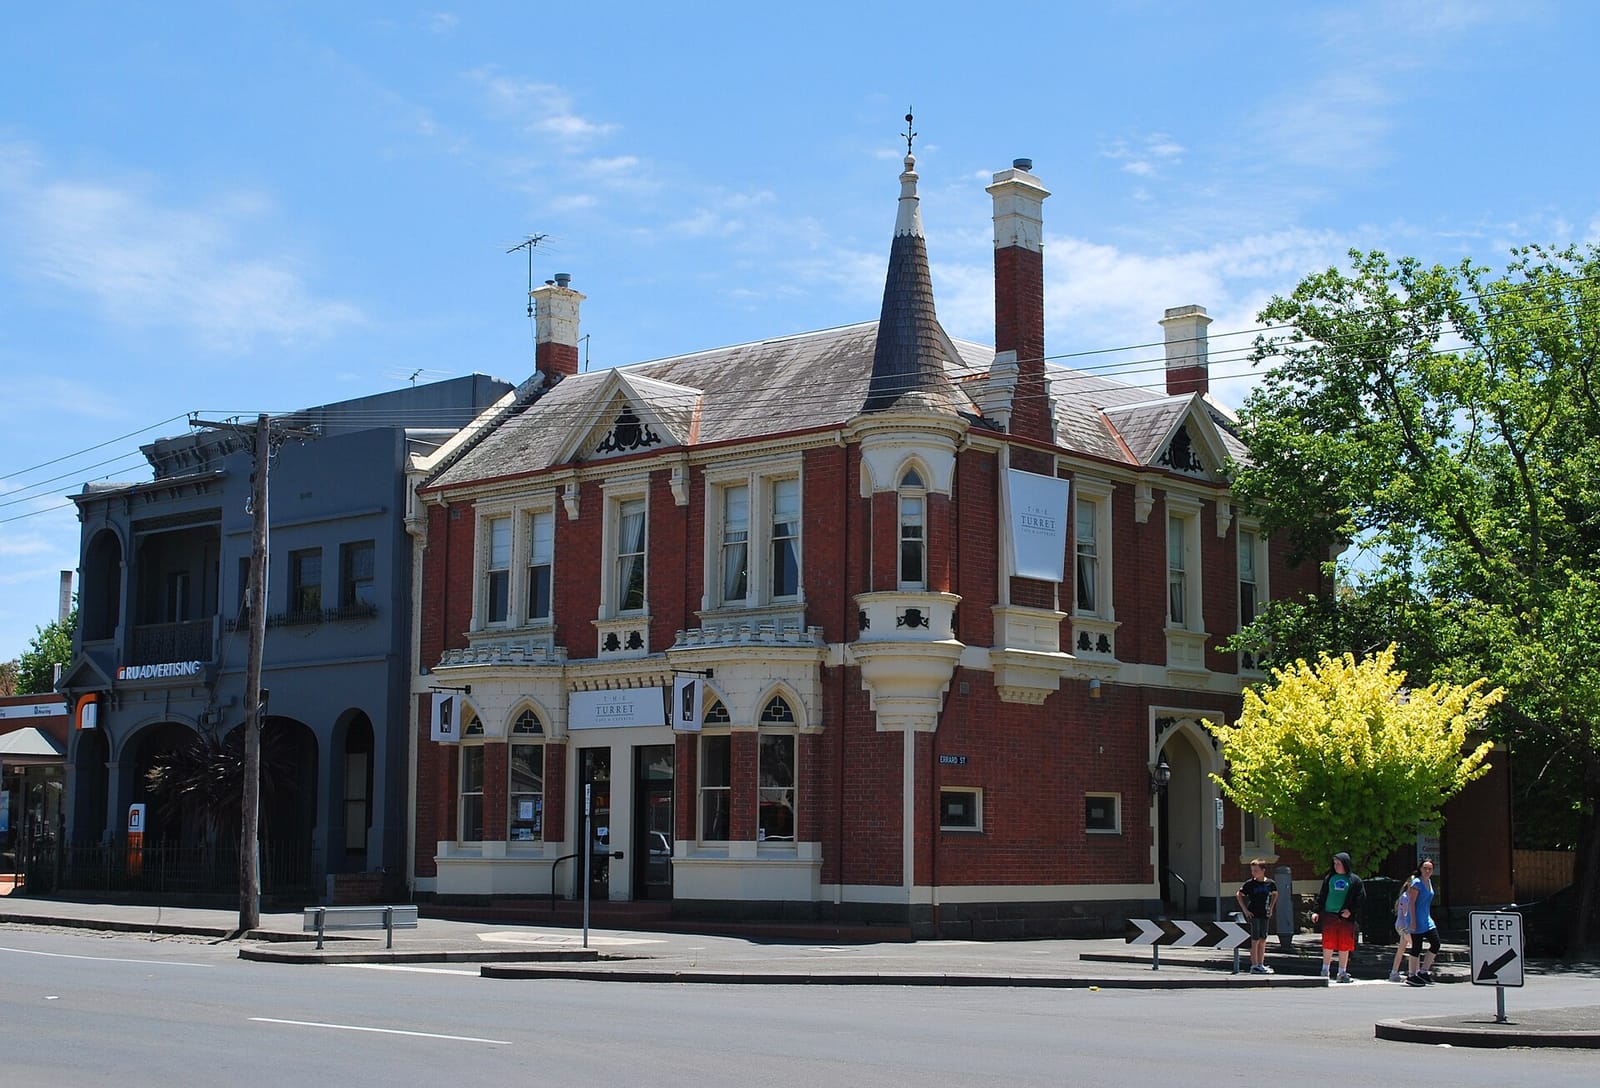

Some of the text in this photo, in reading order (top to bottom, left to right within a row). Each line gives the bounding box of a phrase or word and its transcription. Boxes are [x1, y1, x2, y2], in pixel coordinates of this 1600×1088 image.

[1020, 515, 1056, 529] TURRET
[595, 704, 635, 714] TURRET
[1480, 919, 1513, 930] KEEP
[1481, 934, 1512, 945] LEFT
